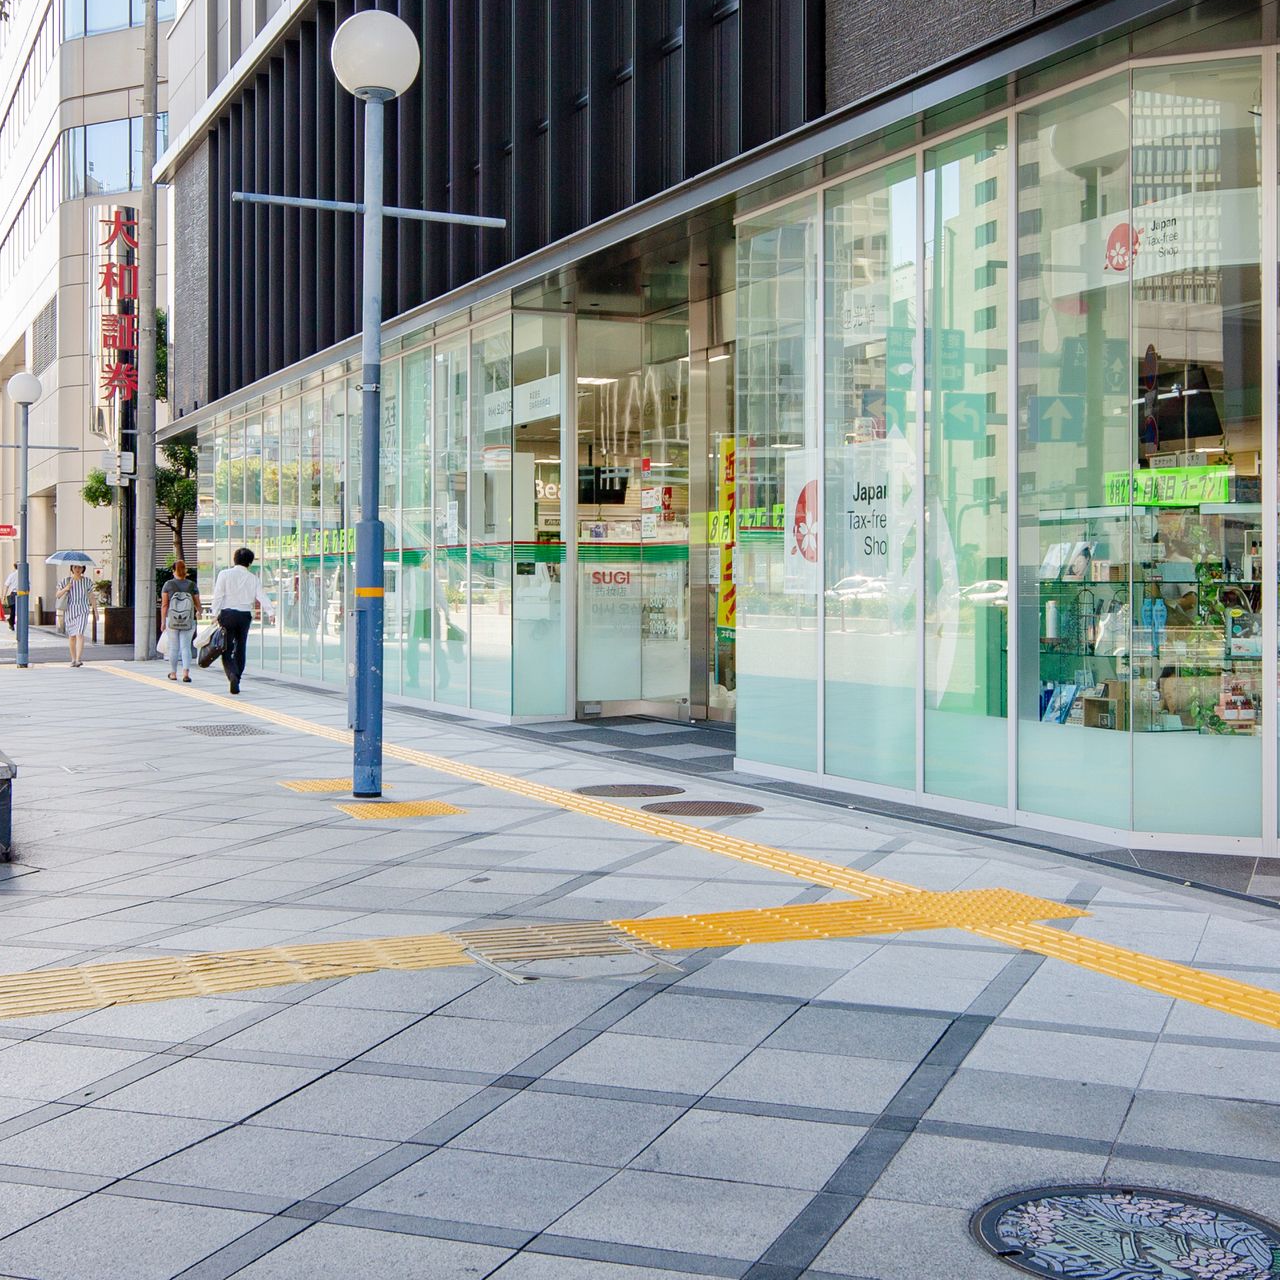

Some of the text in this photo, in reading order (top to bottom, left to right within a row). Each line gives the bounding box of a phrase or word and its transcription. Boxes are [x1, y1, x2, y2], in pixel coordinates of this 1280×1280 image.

[1151, 217, 1177, 232] Japan
[98, 210, 139, 401] 大和証券
[863, 535, 887, 556] Sho
[592, 571, 630, 585] SUGI
